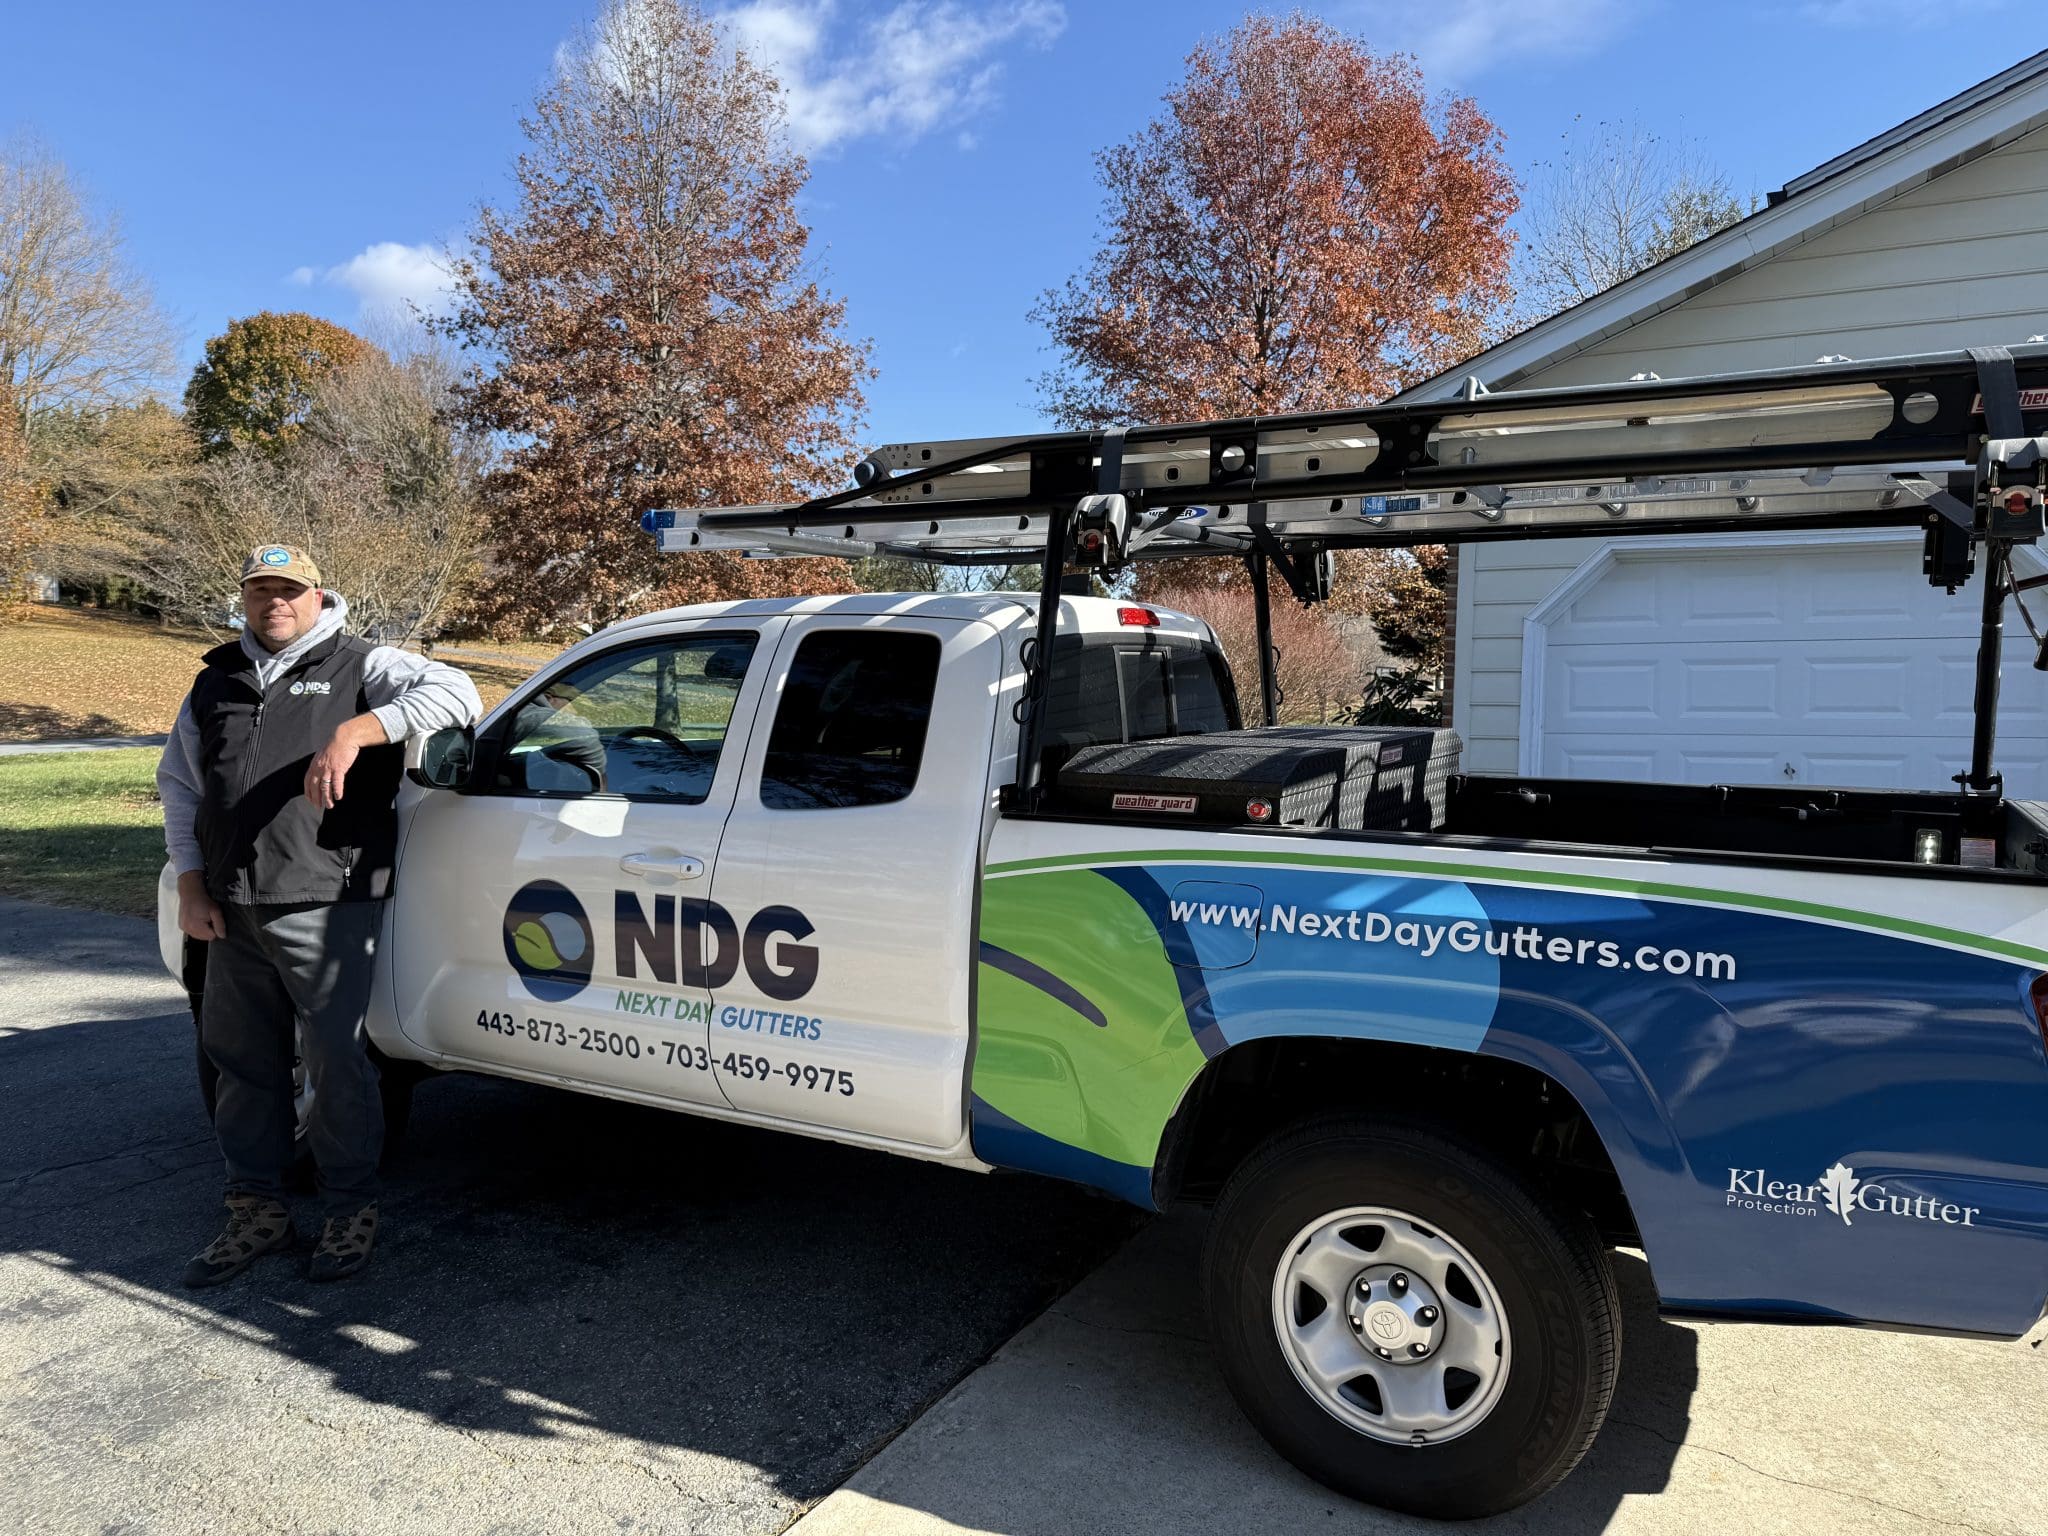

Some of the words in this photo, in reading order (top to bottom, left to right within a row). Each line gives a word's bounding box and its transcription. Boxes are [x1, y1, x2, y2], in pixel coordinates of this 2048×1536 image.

[305, 681, 331, 691] NDG
[1115, 795, 1159, 808] weather
[1161, 798, 1193, 811] guard
[614, 888, 819, 1001] NDG
[1169, 899, 1737, 981] www.NextDayGutters.com
[615, 989, 671, 1019] NEXT
[674, 996, 717, 1025] DAY
[720, 1005, 823, 1041] GUTTERS
[476, 1009, 640, 1059] 443-873-2500
[661, 1041, 856, 1097] 703-459-9975
[1726, 1167, 1822, 1204] Klear
[1857, 1184, 1981, 1227] Gutter
[1726, 1194, 1818, 1217] Protection
